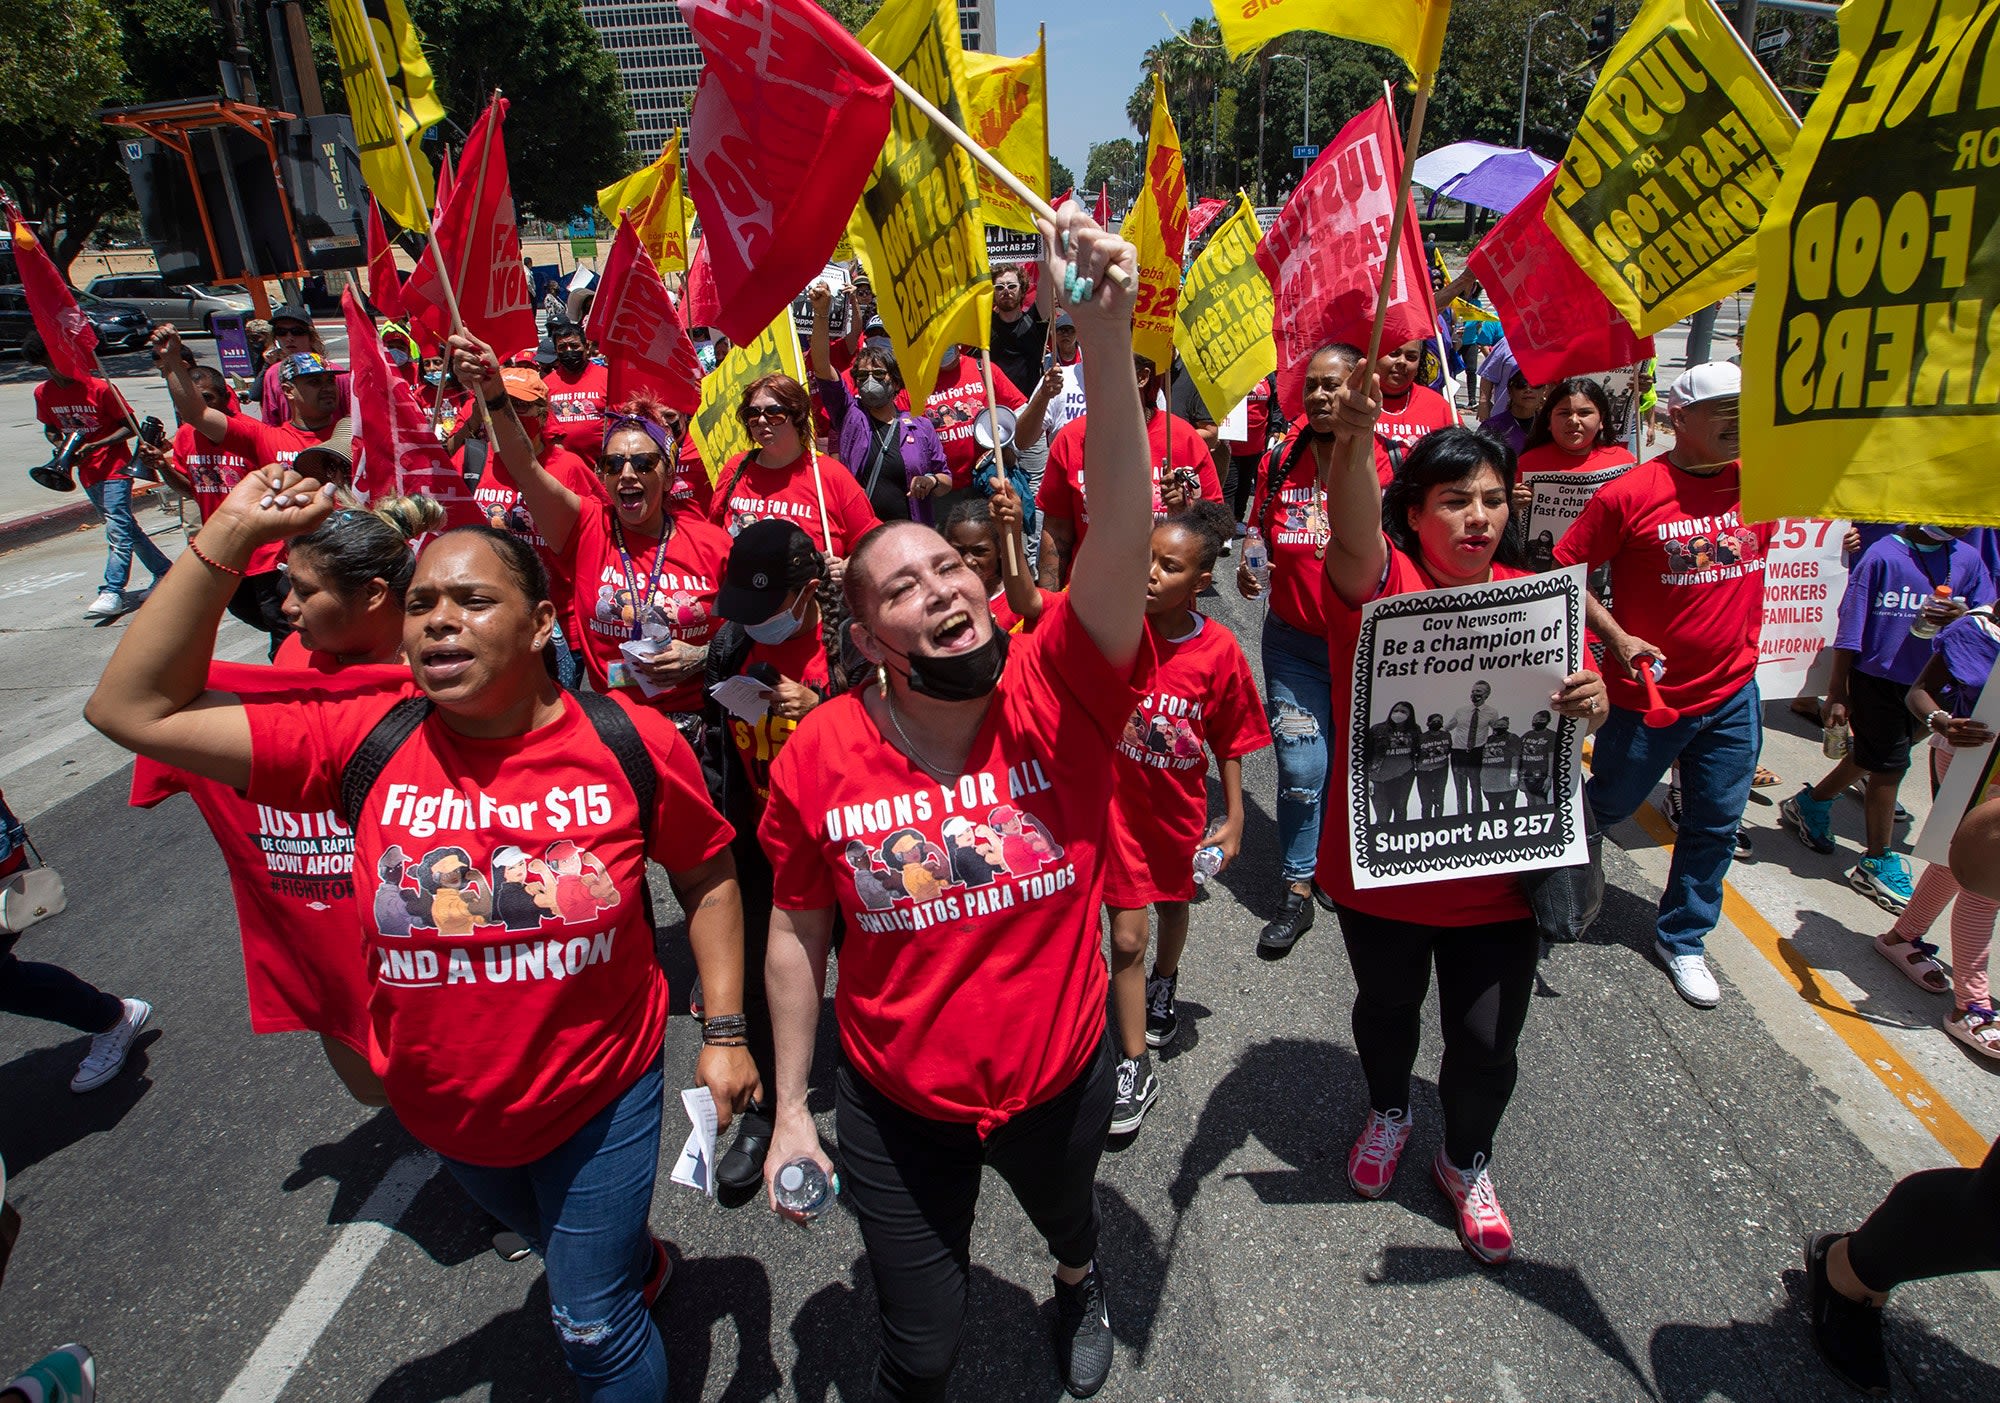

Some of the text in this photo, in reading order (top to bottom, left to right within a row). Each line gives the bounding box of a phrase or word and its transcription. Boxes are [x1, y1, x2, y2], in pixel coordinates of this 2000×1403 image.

[1297, 148, 1306, 156] 1st
[321, 142, 349, 211] WANCO
[986, 243, 1036, 253] pport AB 257
[793, 317, 842, 328] uppo 257
[573, 392, 586, 400] FOR
[587, 391, 600, 399] ALL
[927, 381, 984, 406] ight For $15
[1066, 393, 1087, 404] HO
[949, 429, 958, 441] A
[1393, 424, 1412, 435] FOR
[213, 455, 227, 465] FOR
[229, 455, 245, 467] ALL
[1537, 494, 1589, 507] Be a cha
[1559, 486, 1597, 496] Gov New
[767, 499, 788, 516] FOR
[791, 503, 812, 519] ALL
[1534, 505, 1582, 519] fast foo
[1658, 516, 1712, 541] UNIONS
[1769, 517, 1833, 549] 257
[1661, 569, 1718, 586] SINDICATOS
[1720, 566, 1742, 580] PARA
[1769, 561, 1819, 579] WAGES
[650, 573, 680, 590] OR
[683, 575, 711, 591] ALL
[1423, 610, 1527, 632] Gov Newsom:
[1763, 607, 1824, 625] FAMILIES
[589, 618, 710, 640] SINDICAT TODOS
[1382, 619, 1563, 657] Be a champion of
[1760, 638, 1826, 655] ALIFORNIA
[1376, 646, 1564, 678] fast food workers
[1158, 693, 1188, 717] FOR
[1115, 741, 1143, 762] ATOS
[1145, 752, 1171, 769] PARA
[381, 783, 613, 838] Fight For $15
[826, 759, 1053, 842] UNIONS FOR ALL
[257, 804, 354, 838] JUSTIC
[1375, 813, 1555, 854] Support AB 257
[261, 837, 275, 852] DE
[275, 838, 320, 855] COMIDA
[266, 852, 355, 875] NOW! AHOR
[855, 863, 1076, 934] SINDICATOS PARA TODOS
[378, 927, 616, 985] AND A UNION
